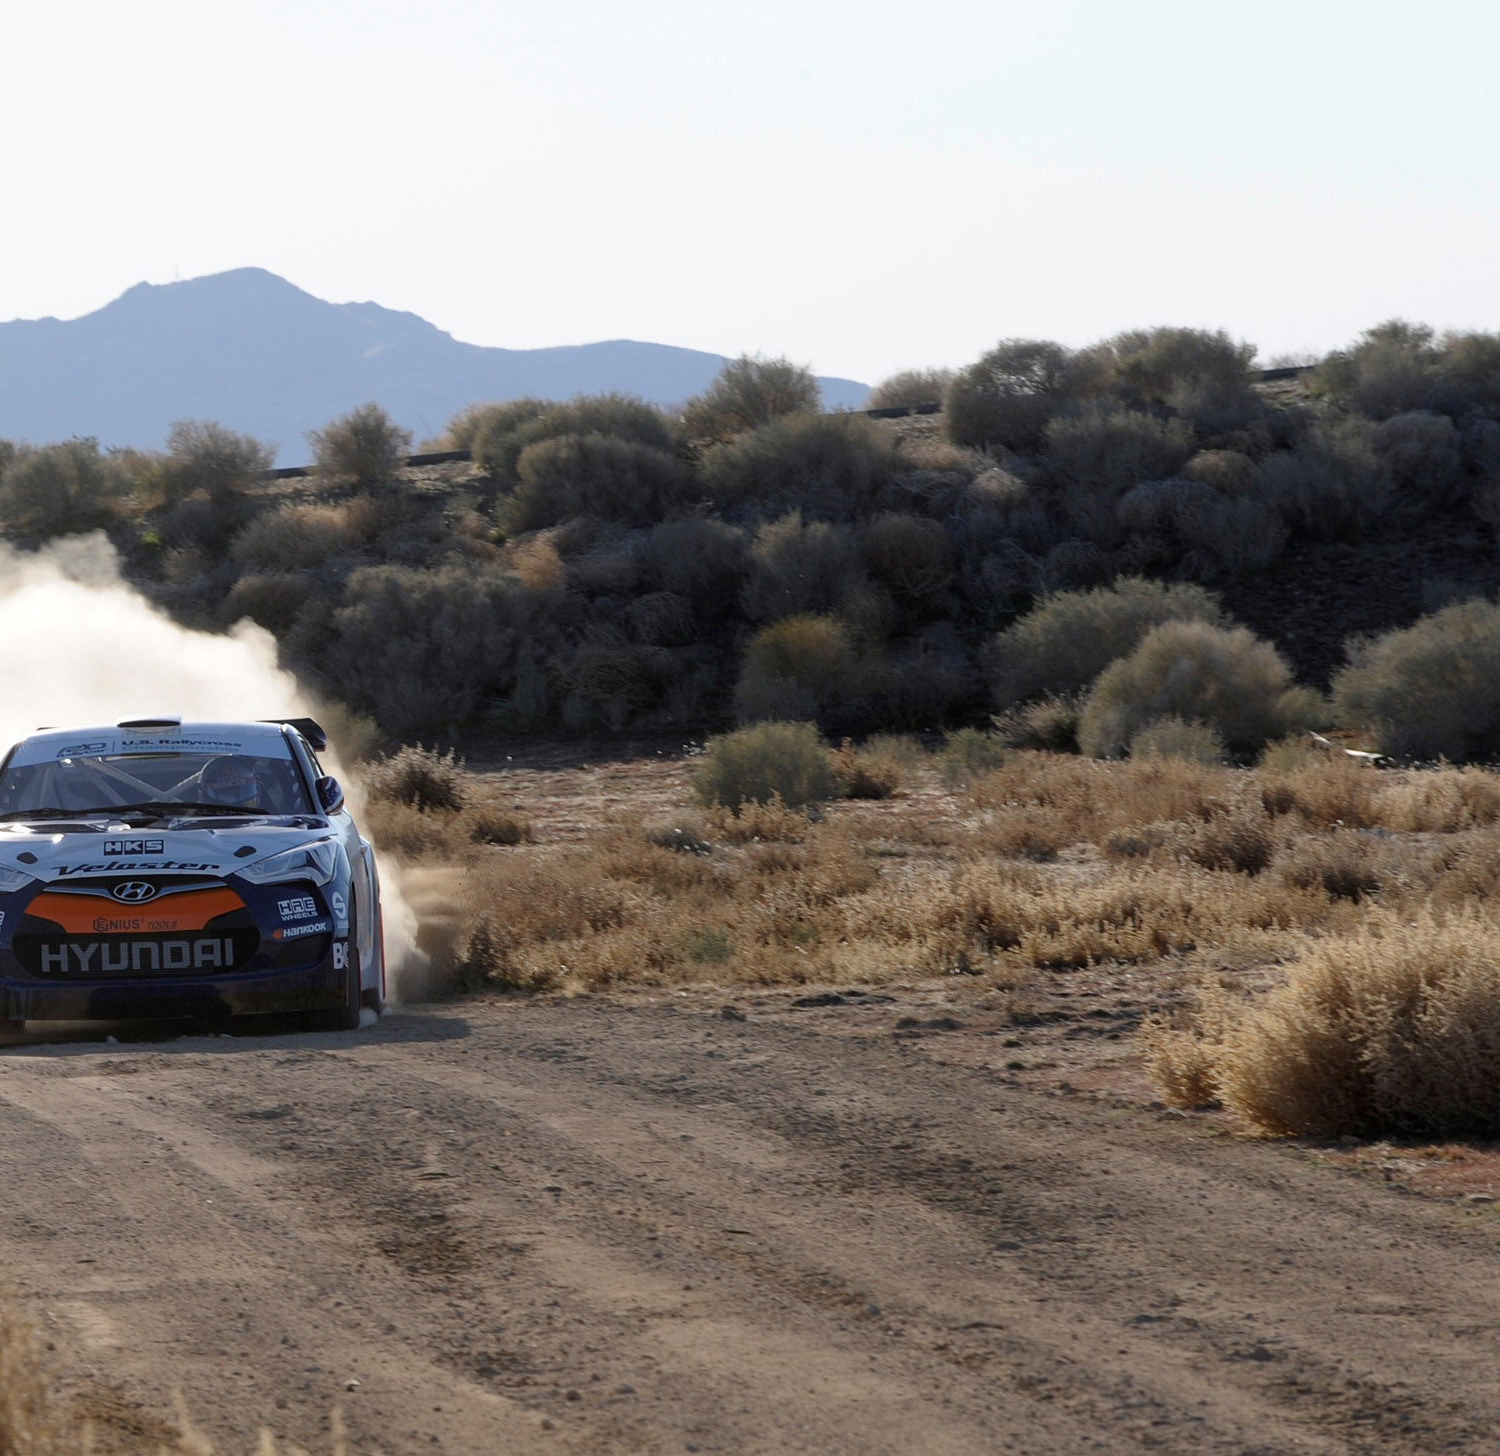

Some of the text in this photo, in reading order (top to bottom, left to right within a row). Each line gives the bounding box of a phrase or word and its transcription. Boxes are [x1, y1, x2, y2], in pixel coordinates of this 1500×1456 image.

[159, 739, 242, 748] Rallycross
[103, 839, 164, 856] HKS
[52, 861, 221, 876] Veloster
[277, 896, 317, 915] HRE
[281, 910, 319, 921] WHEELS
[147, 920, 179, 929] TOOLS
[41, 938, 234, 972] HYUNDAI
